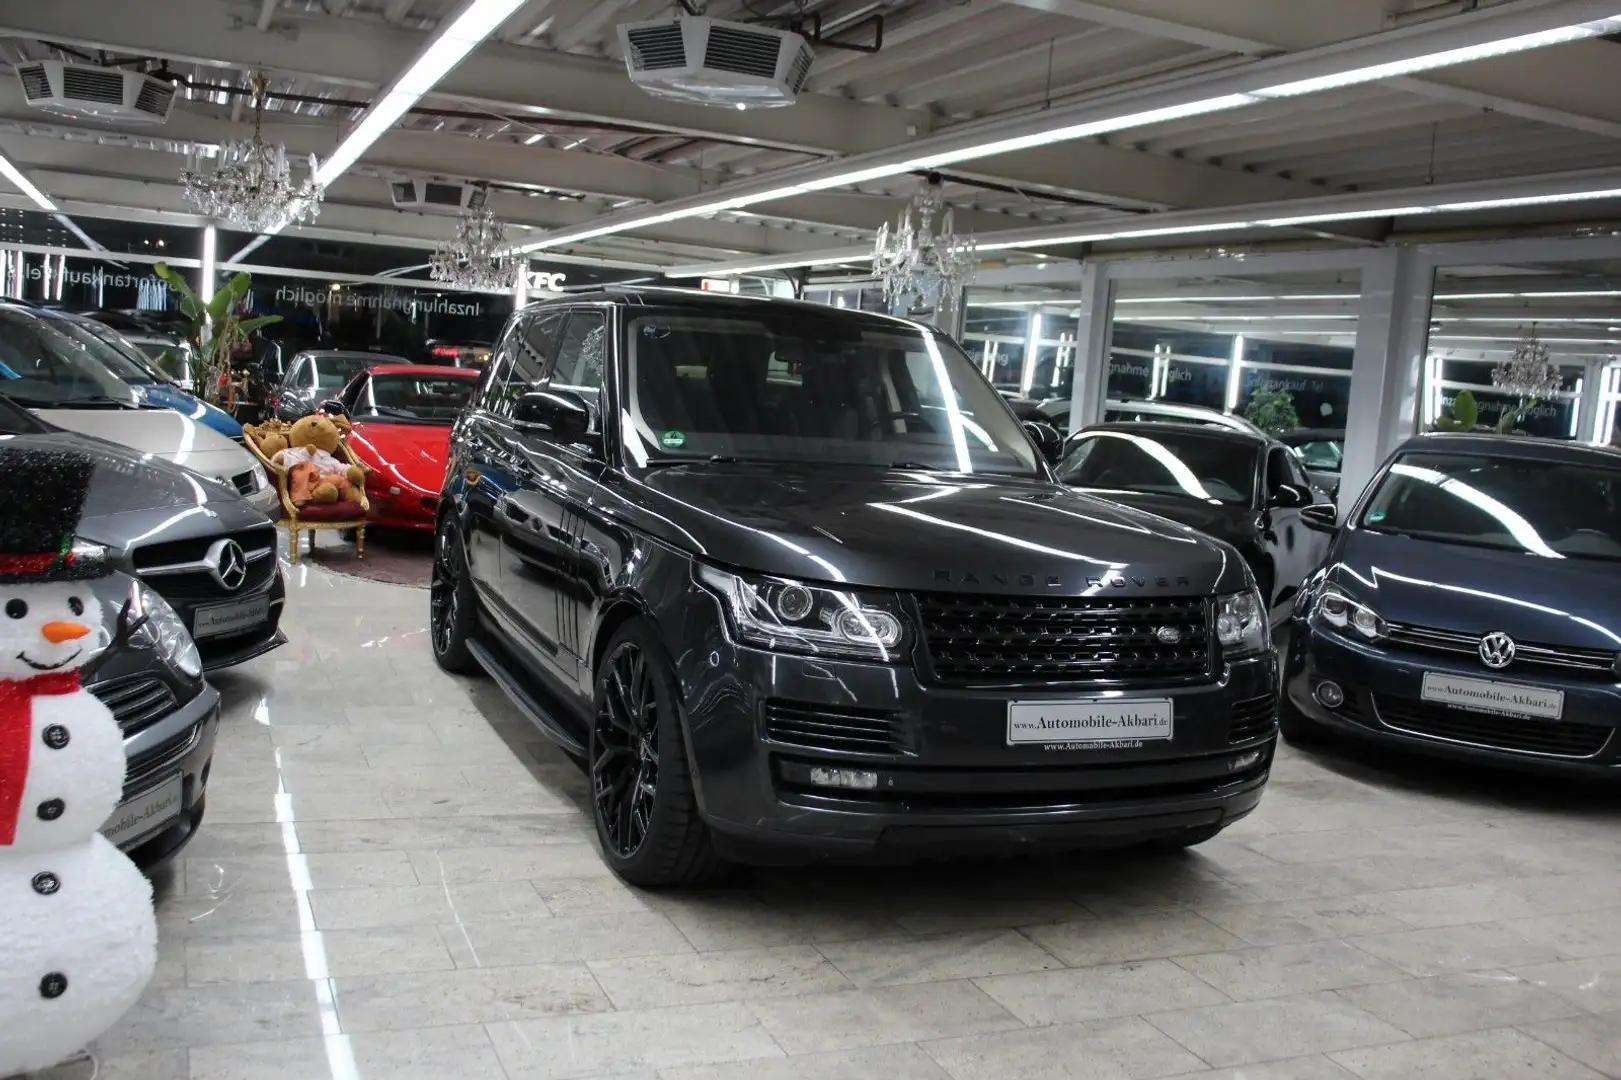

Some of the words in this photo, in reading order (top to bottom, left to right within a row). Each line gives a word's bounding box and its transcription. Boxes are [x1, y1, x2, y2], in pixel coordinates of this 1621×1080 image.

[933, 569, 1063, 588] RANGE
[1085, 574, 1192, 589] ROVER
[1013, 713, 1169, 731] www.Automobile-Akbari.de
[1043, 739, 1144, 751] www.Automobile-Akbari.de
